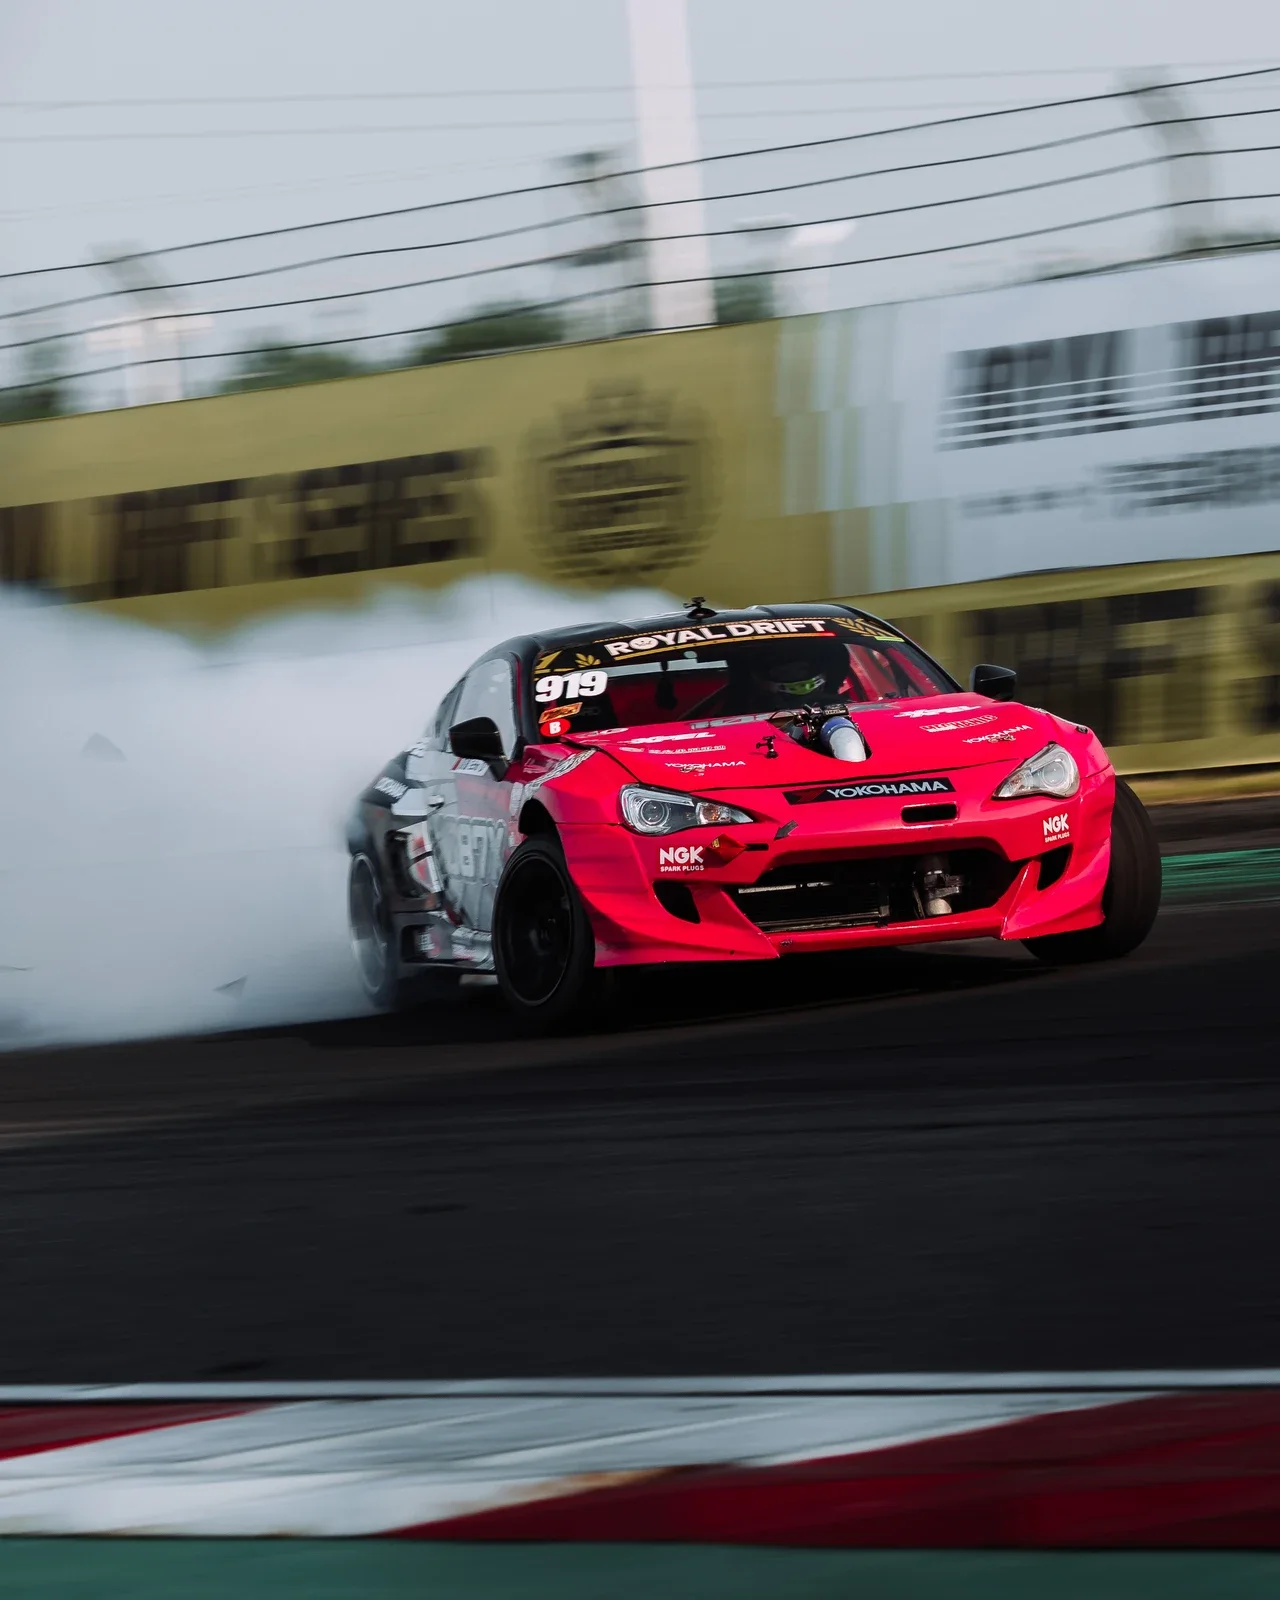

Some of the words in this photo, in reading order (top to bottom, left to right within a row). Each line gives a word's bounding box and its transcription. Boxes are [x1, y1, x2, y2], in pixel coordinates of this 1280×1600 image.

[604, 627, 727, 656] ROYAL
[724, 620, 825, 637] DRIFT
[535, 671, 608, 702] 919
[549, 721, 562, 735] B
[665, 761, 746, 769] YOKOHAMA
[826, 780, 949, 798] YOKOHAMA
[1042, 812, 1070, 836] NGK
[659, 845, 704, 865] NGK
[660, 865, 682, 873] SPARK
[682, 864, 705, 872] PLUGS
